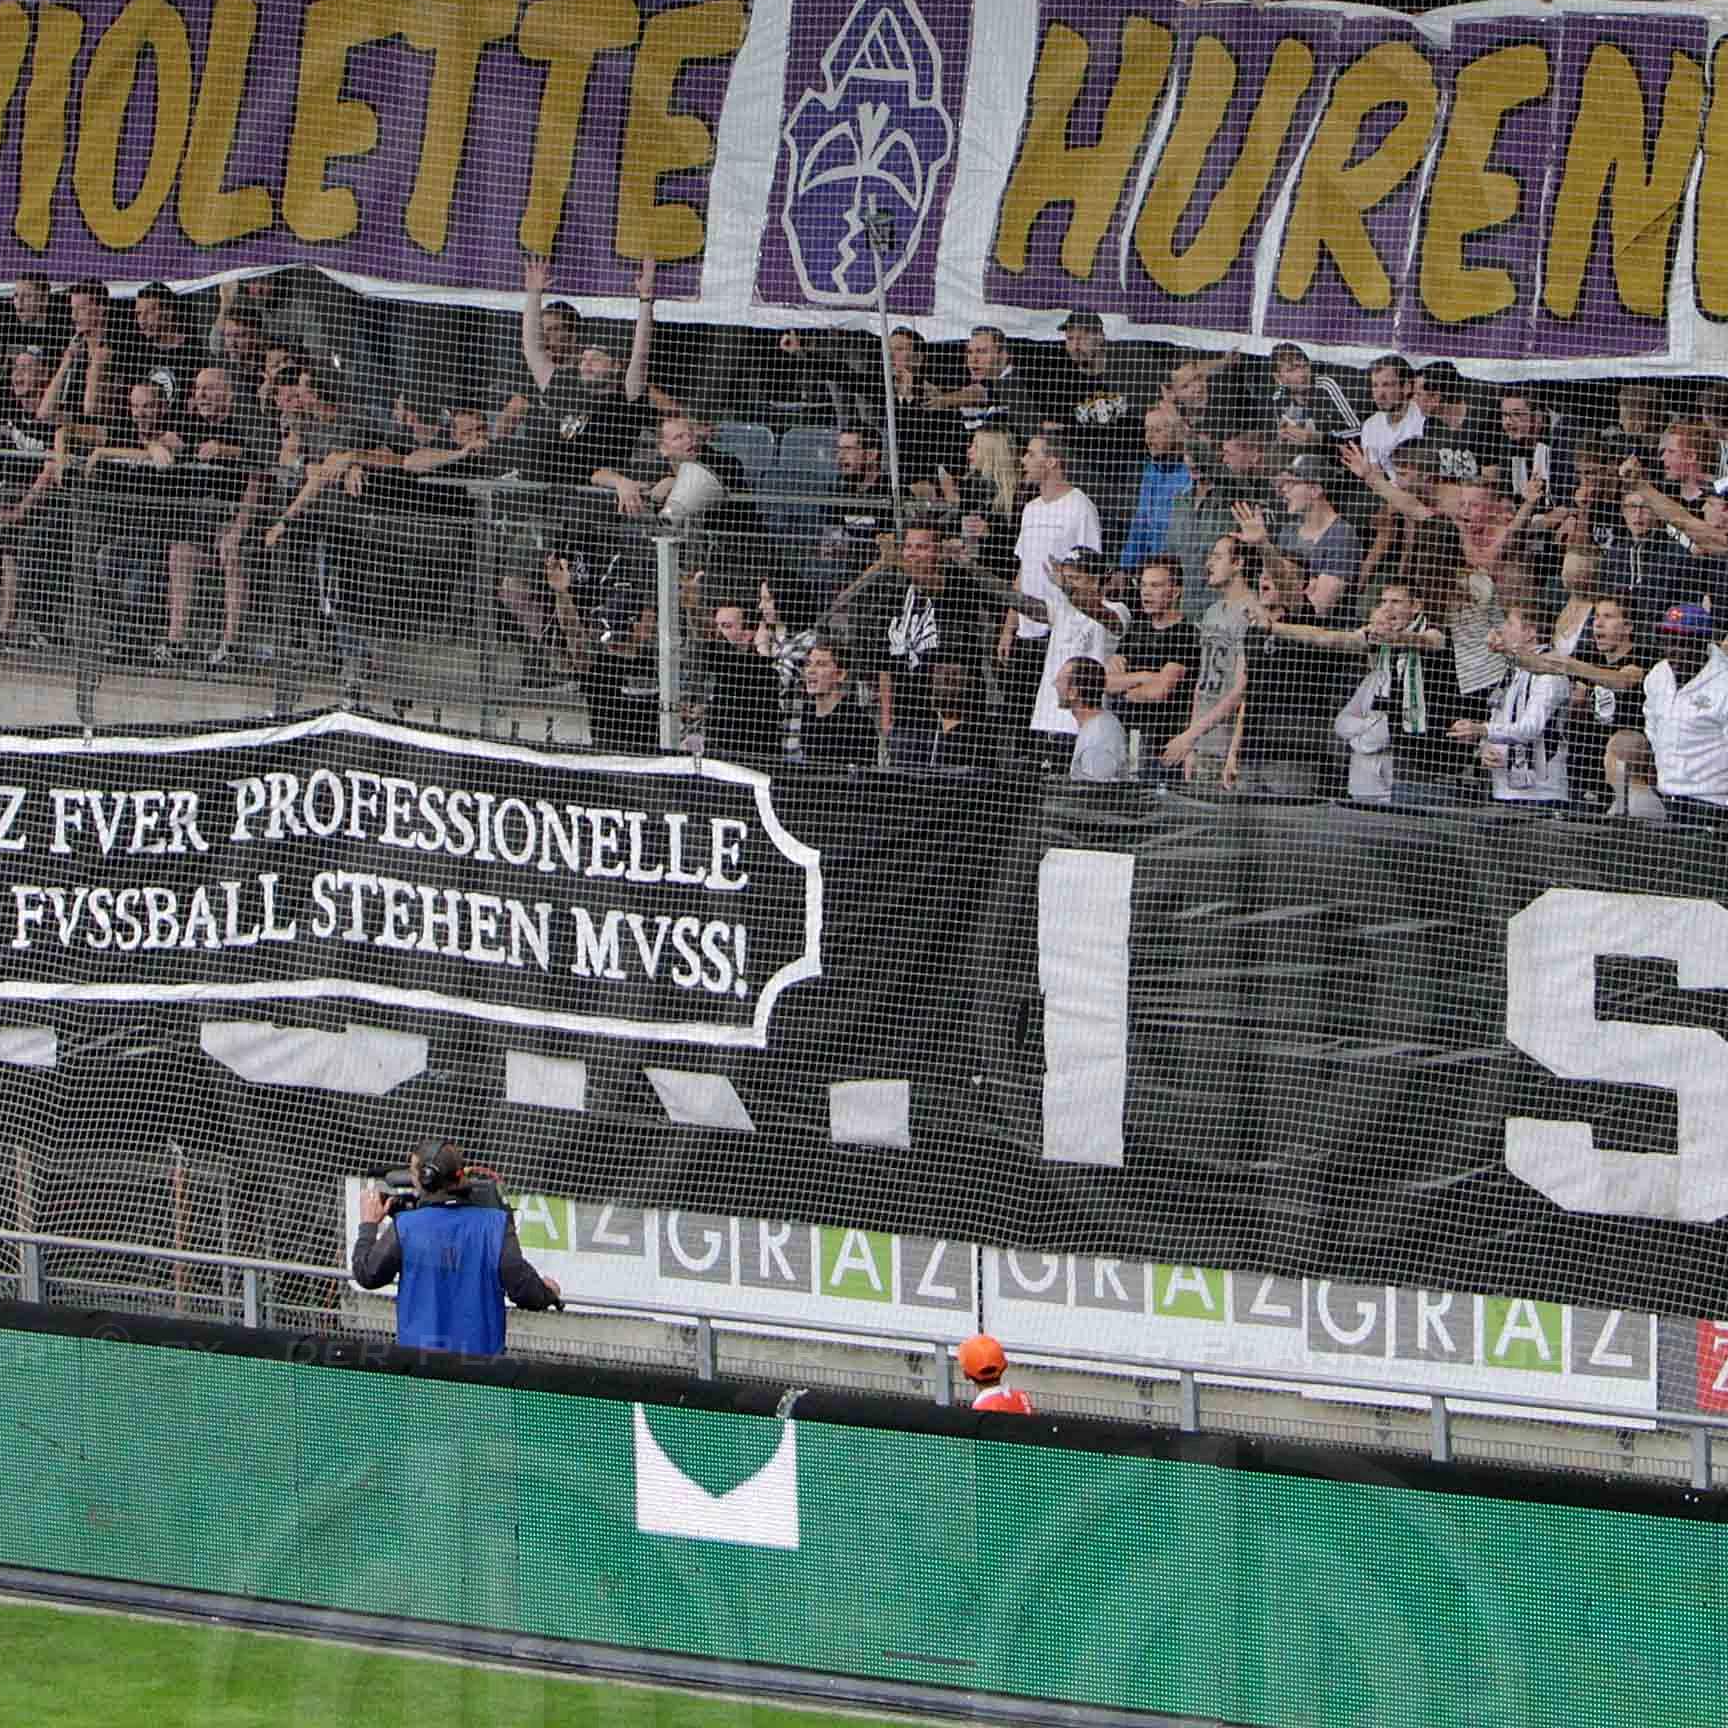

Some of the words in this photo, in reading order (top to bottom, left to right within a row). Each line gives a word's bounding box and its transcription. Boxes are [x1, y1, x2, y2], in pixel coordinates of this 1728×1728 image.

[48, 788, 211, 857] FVER
[228, 768, 750, 892] PROFESSIONELLE
[11, 872, 298, 952] FVSSBALL
[310, 870, 552, 978] STEHEN
[571, 905, 750, 1000] MVSS!
[665, 1210, 958, 1300] GRAZ
[1314, 1279, 1634, 1369] GRAZ
